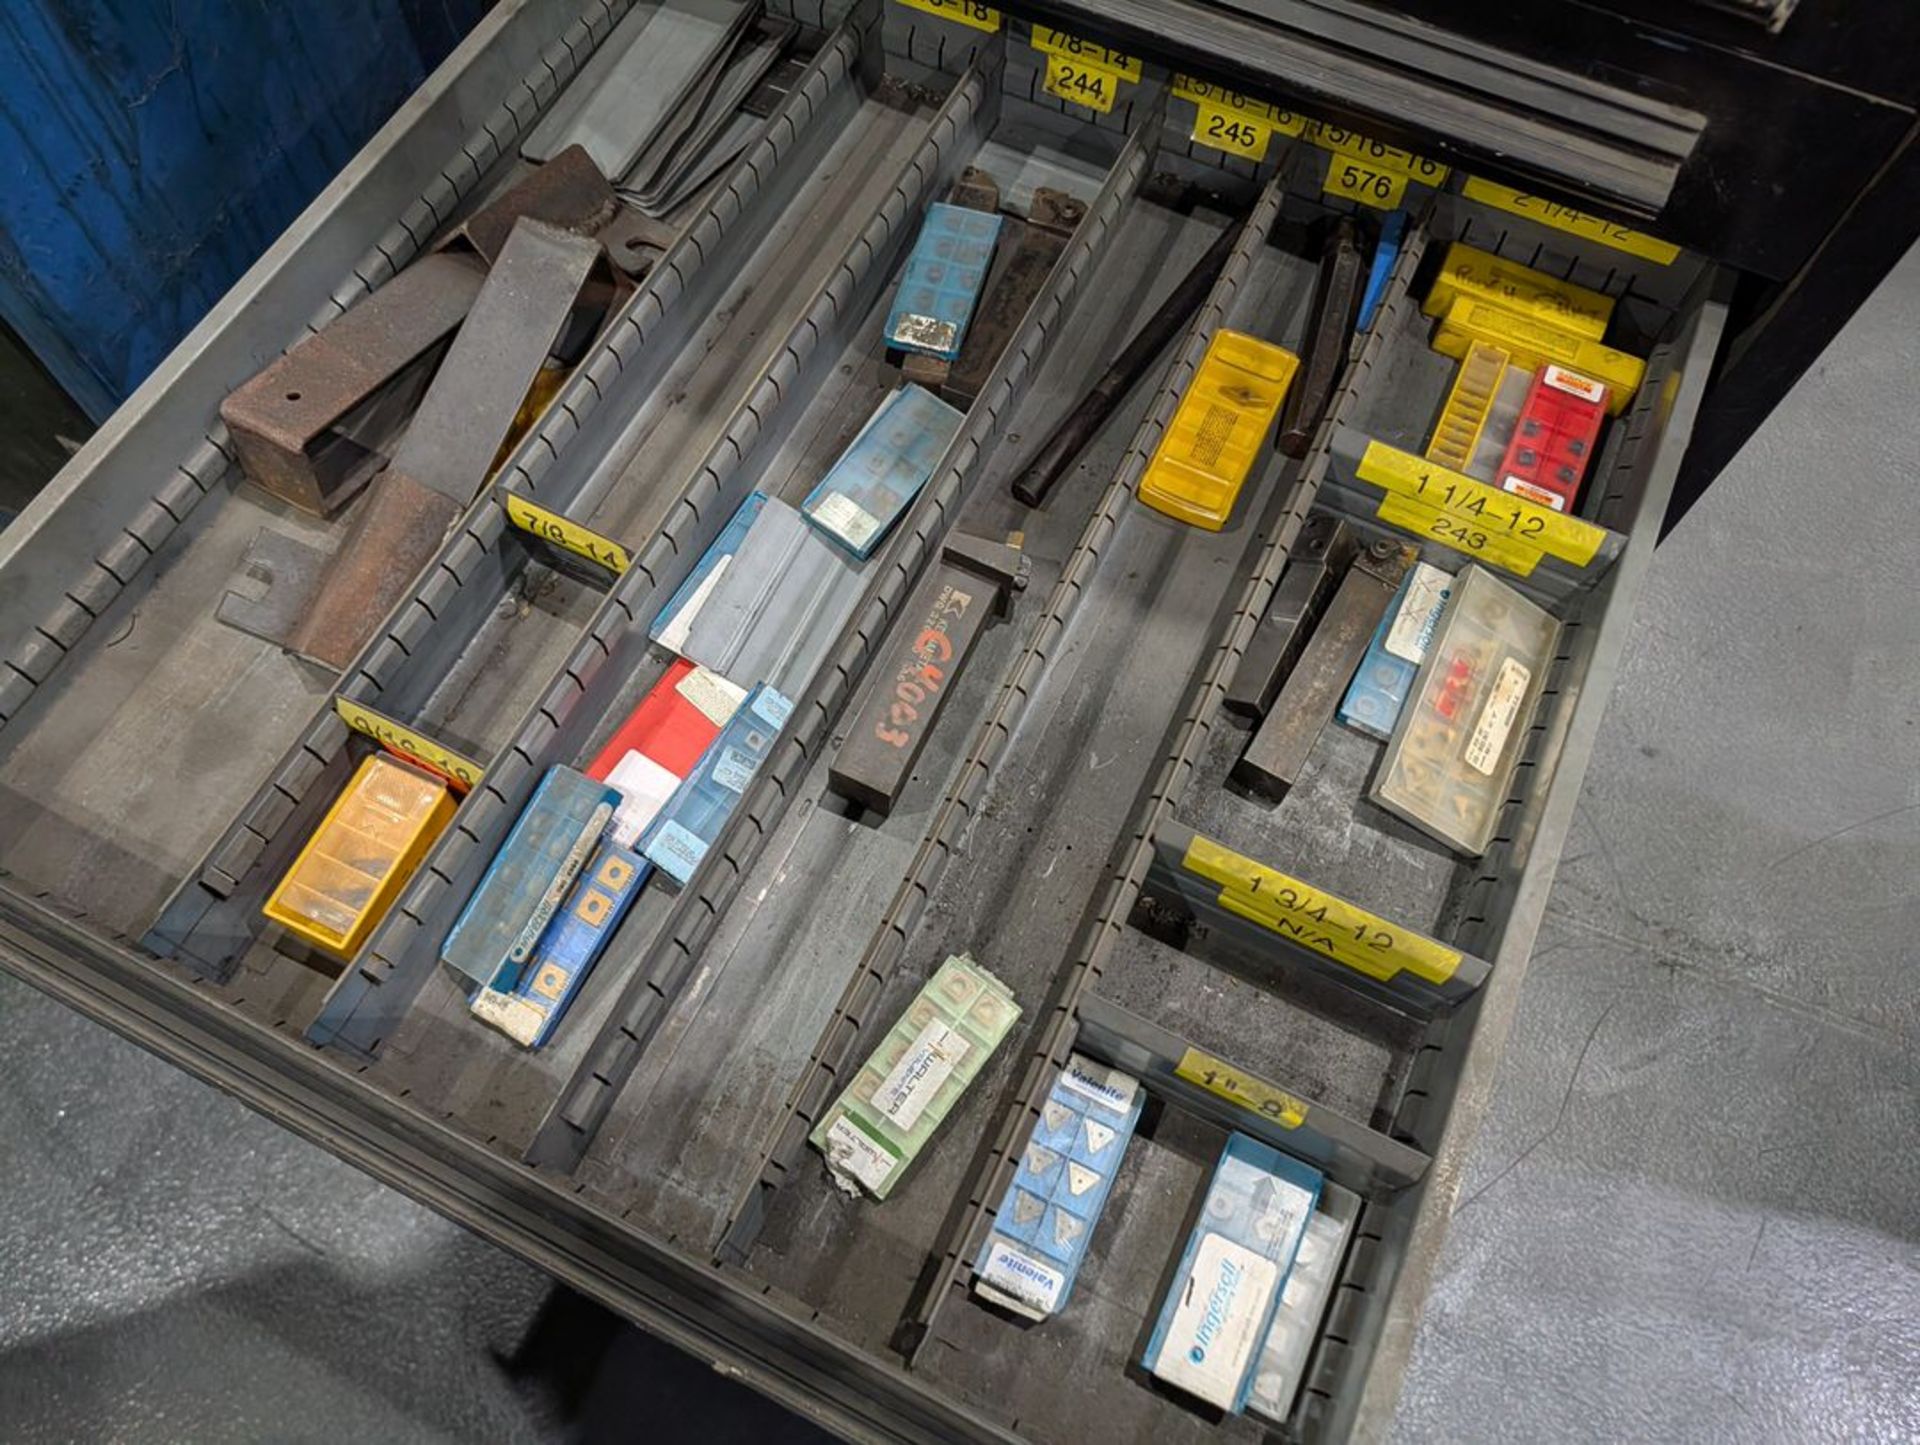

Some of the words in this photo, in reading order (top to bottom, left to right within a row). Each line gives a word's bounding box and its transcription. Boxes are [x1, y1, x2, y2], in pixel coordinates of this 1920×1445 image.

[1058, 66, 1103, 99] 244
[1209, 115, 1256, 148] 245
[1341, 165, 1391, 199] 576
[1417, 474, 1430, 494] 1
[1443, 484, 1546, 540] 1/4-12
[1430, 518, 1487, 550] 243
[1250, 876, 1261, 892] 1
[1274, 889, 1394, 953] 3/4-12
[1278, 918, 1335, 952] N/A
[999, 1254, 1054, 1291] Valenite
[1200, 1257, 1237, 1346] Ingersoll
